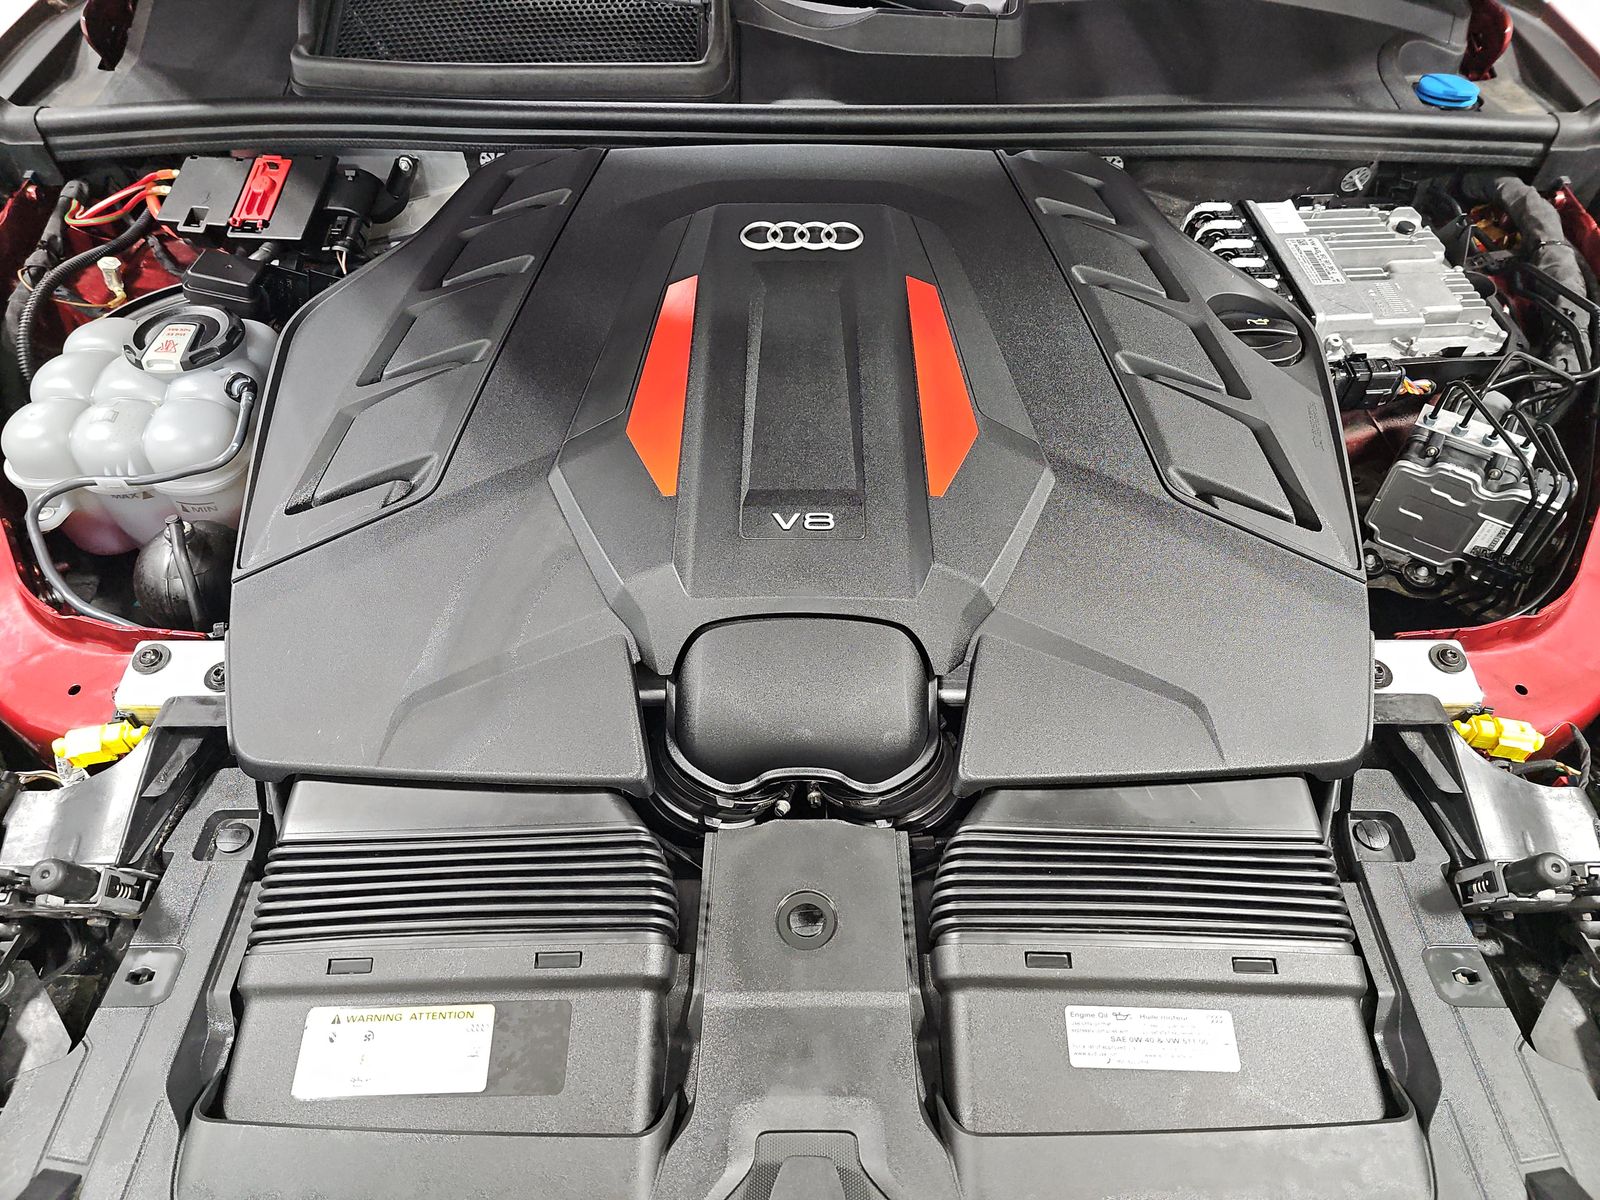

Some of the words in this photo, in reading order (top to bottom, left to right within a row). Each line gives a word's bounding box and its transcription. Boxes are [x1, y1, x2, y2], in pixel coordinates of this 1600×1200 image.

[191, 505, 218, 513] MIN
[771, 512, 835, 530] V8
[346, 1013, 403, 1024] WARNING
[409, 1010, 475, 1021] ATTENTION
[1070, 1011, 1096, 1019] Engine
[1110, 1035, 1127, 1043] SAE
